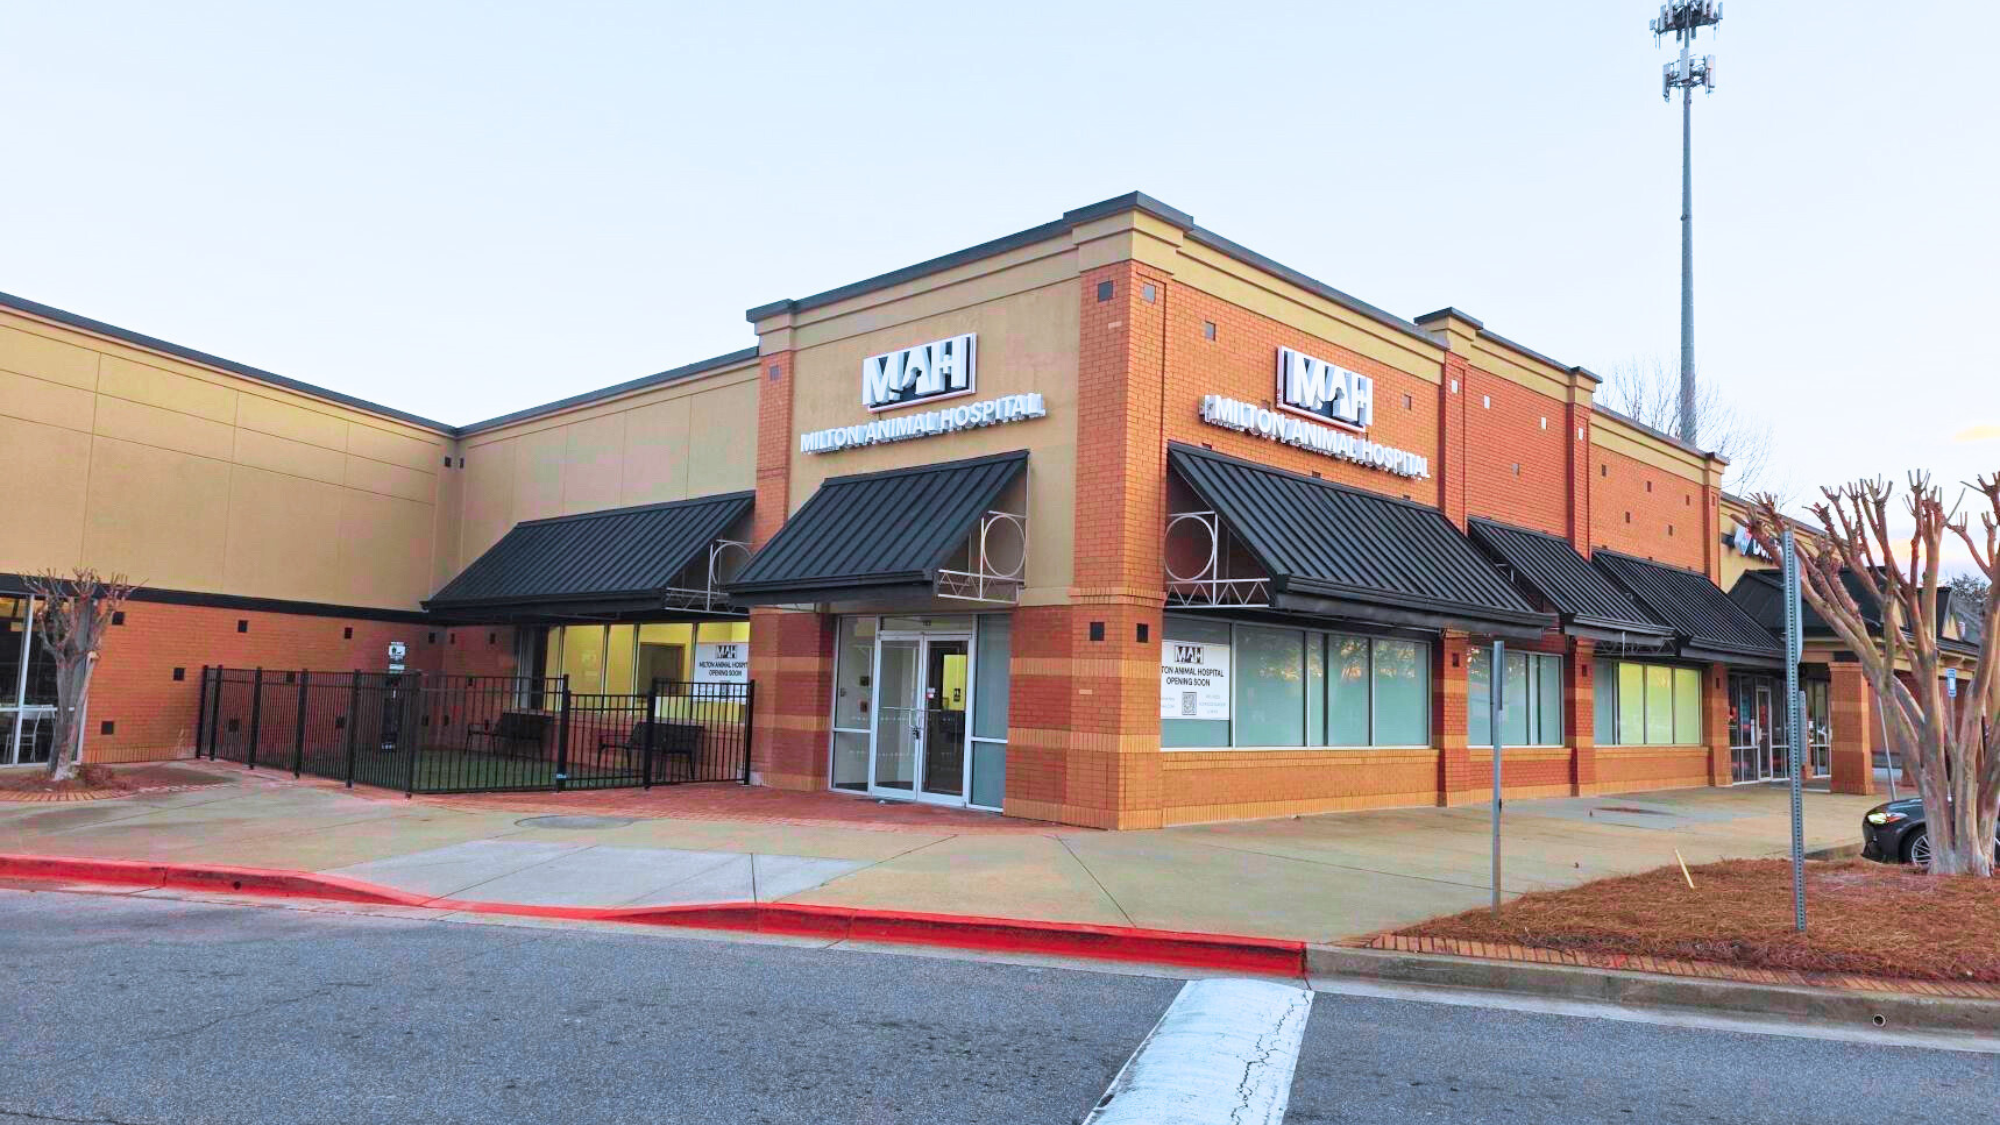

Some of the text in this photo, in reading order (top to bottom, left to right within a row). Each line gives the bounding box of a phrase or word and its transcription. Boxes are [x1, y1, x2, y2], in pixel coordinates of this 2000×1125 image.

[863, 336, 968, 405] MAH
[1288, 350, 1373, 426] MAH
[801, 393, 1045, 453] MILTON ANIMAL HOSPITAL
[1205, 395, 1431, 481] MILTON ANIMAL HOSPITAL
[1166, 676, 1211, 687] OPENING SOON
[1174, 645, 1204, 664] MAH
[1174, 666, 1196, 676] ANIMAL
[1197, 667, 1225, 678] HOSPITAL
